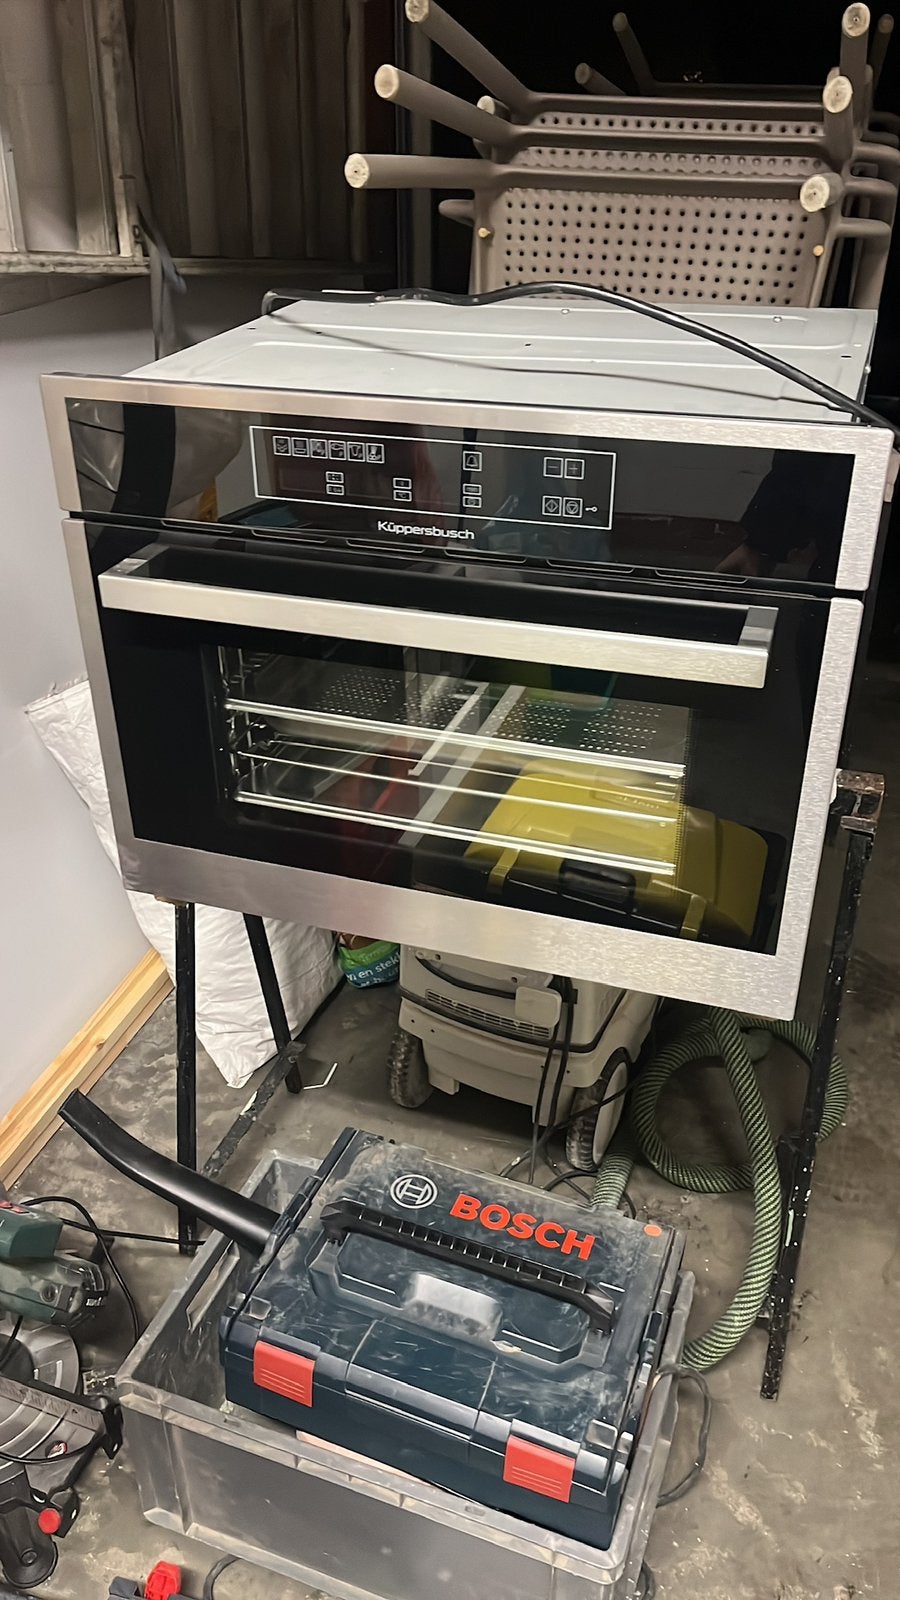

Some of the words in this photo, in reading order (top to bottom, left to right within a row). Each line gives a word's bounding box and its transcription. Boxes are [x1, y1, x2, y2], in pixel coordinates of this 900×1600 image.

[377, 520, 475, 540] Küppersbusch
[358, 969, 374, 979] en
[449, 1193, 596, 1261] BOSCH
